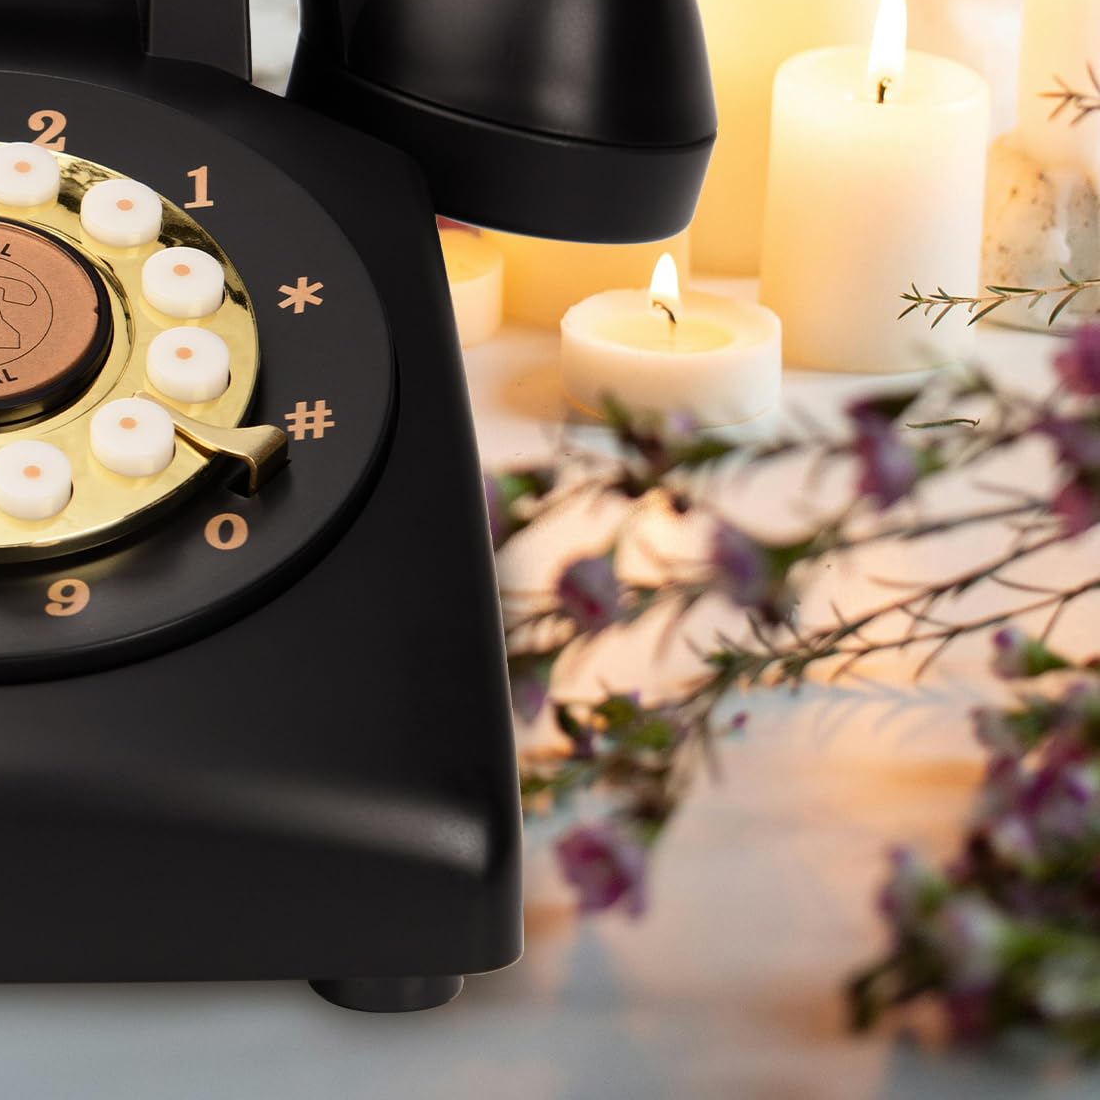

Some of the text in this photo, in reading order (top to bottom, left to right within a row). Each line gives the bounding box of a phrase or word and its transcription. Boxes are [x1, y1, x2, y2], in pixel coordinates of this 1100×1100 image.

[28, 110, 66, 151] 2
[186, 166, 213, 208] 1
[284, 399, 336, 441] #
[204, 512, 249, 551] 0
[45, 579, 91, 617] 9
